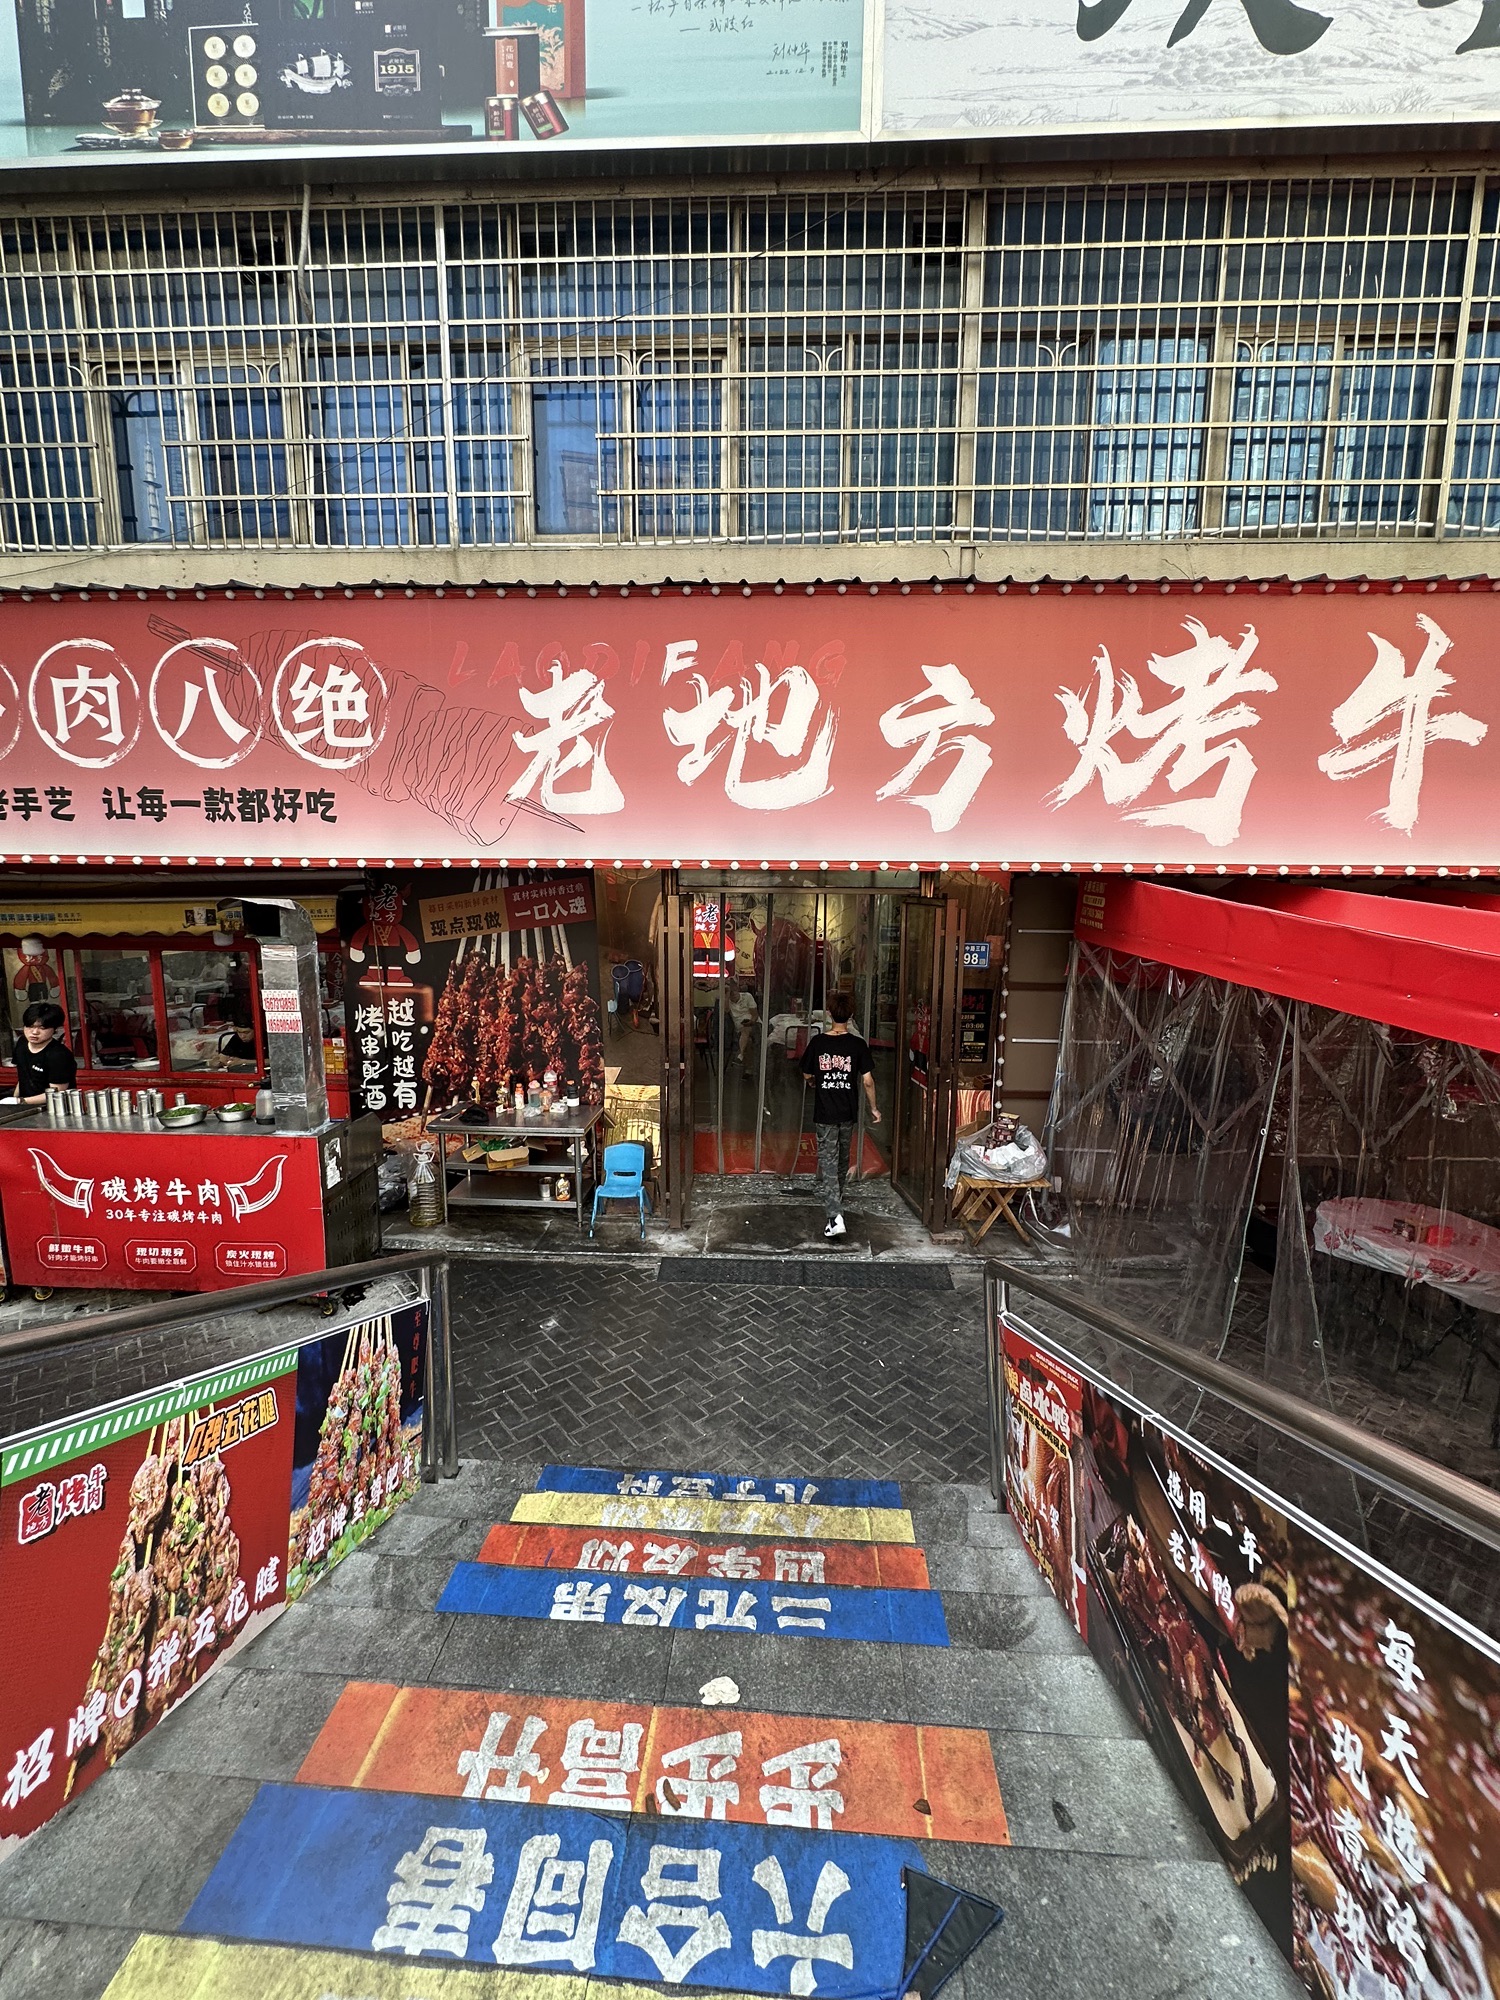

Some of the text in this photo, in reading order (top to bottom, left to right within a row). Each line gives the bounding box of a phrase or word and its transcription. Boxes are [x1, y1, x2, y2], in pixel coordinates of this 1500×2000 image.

[380, 64, 414, 74] 1915
[103, 787, 338, 825] 让每一款都好吃
[511, 882, 585, 902] 真材实料鲜香过瘾
[514, 896, 588, 921] 一口入魂
[430, 911, 502, 937] 现点现做
[355, 1003, 388, 1110] 烤串配酒
[387, 997, 418, 1110] 越吃越有
[100, 1176, 221, 1207] 碳烤牛肉
[105, 1208, 223, 1226] 30年专注碳烤牛肉
[47, 1254, 99, 1263] 好肉才能烤好串
[48, 1243, 95, 1255] 鲜嫩牛肉
[136, 1247, 184, 1257] 现切现穿
[226, 1250, 275, 1260] 炭火现烤
[410, 1310, 423, 1399] 至尊肥牛
[305, 1452, 413, 1560] 招牌至尊肥牛
[1166, 1469, 1263, 1574] 选用一年
[1167, 1529, 1235, 1622] 老水鸭
[371, 1826, 853, 1995] 六合同春
